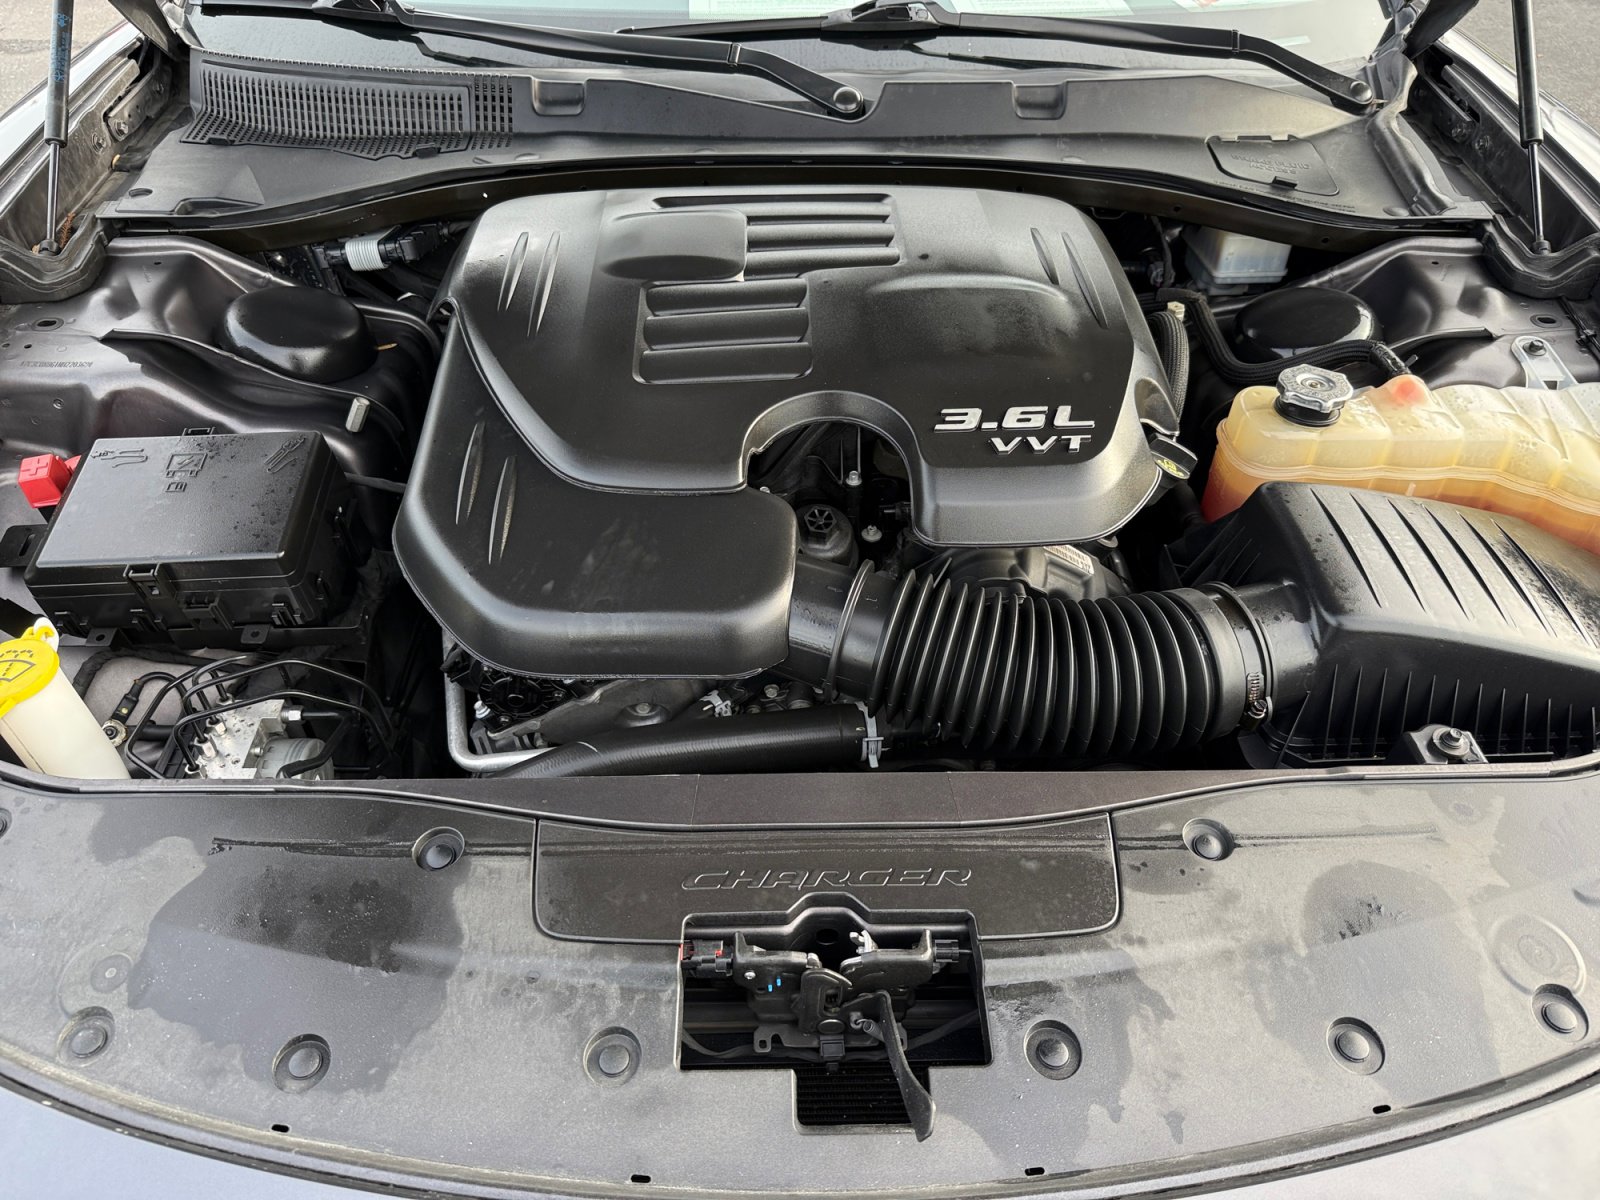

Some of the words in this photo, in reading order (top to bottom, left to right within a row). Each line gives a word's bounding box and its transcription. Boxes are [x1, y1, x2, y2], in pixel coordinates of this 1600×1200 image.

[933, 405, 1096, 433] 3.6L
[988, 434, 1092, 456] VVT
[681, 867, 972, 891] CHARGER
